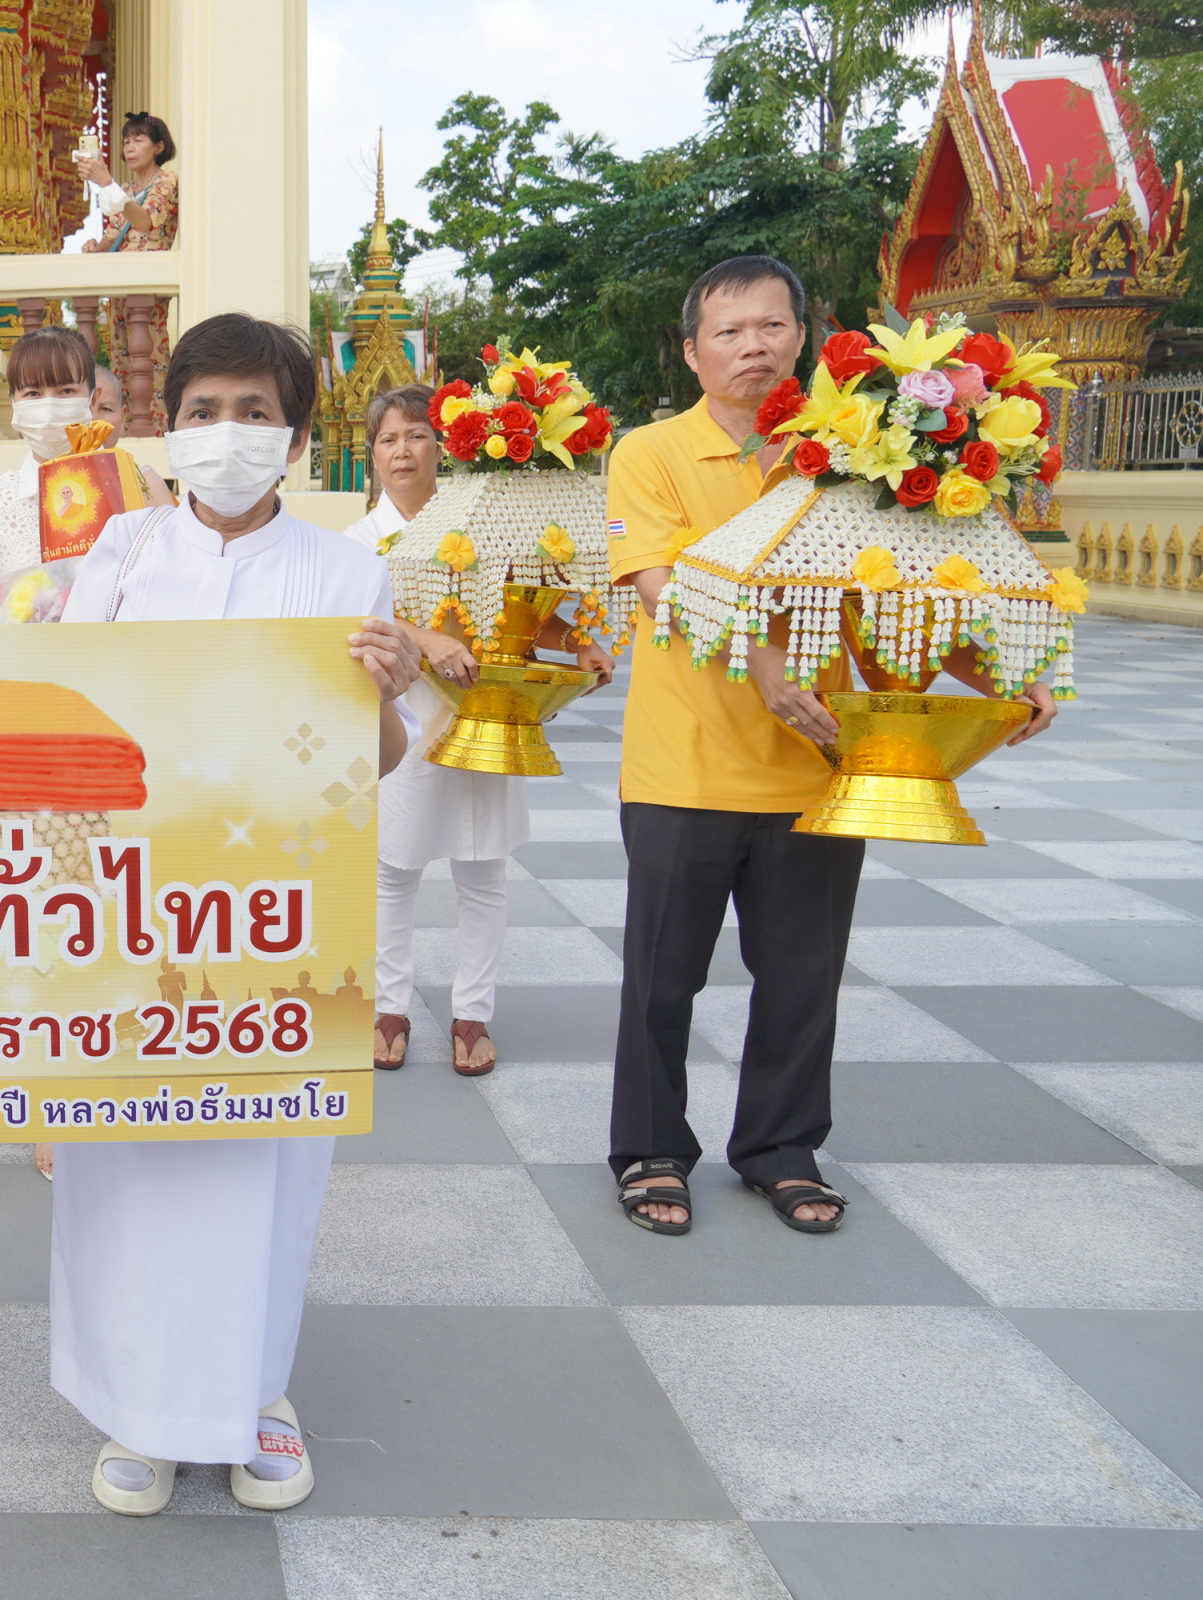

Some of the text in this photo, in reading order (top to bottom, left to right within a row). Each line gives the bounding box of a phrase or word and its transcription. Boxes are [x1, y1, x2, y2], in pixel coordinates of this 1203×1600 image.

[140, 1002, 309, 1056] 2568
[0, 1089, 27, 1124] ปี
[43, 1081, 345, 1123] หลวงพ่อธัมมชโย
[260, 1440, 304, 1456] KITTY
